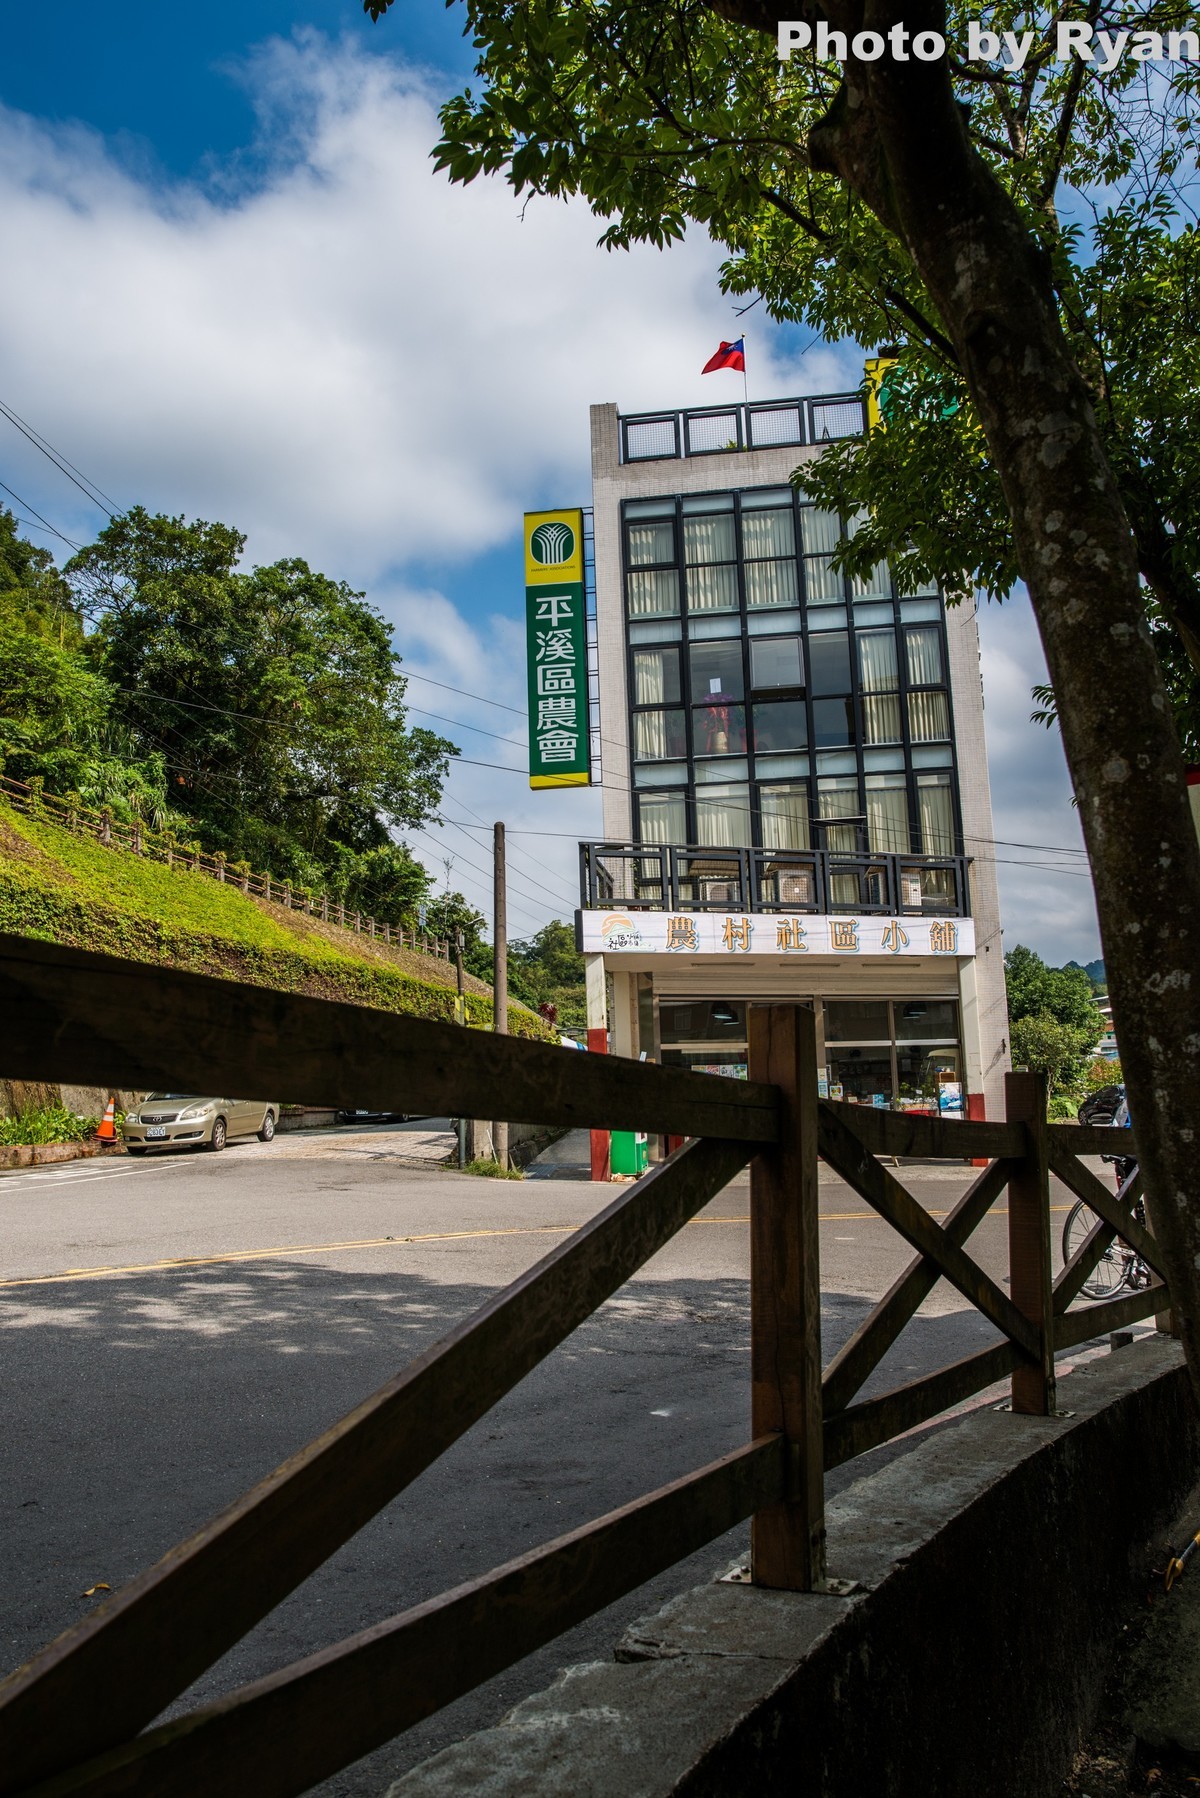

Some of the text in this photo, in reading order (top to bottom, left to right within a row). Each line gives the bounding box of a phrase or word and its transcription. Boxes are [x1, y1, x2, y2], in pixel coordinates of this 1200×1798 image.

[535, 595, 579, 763] 平溪區農會
